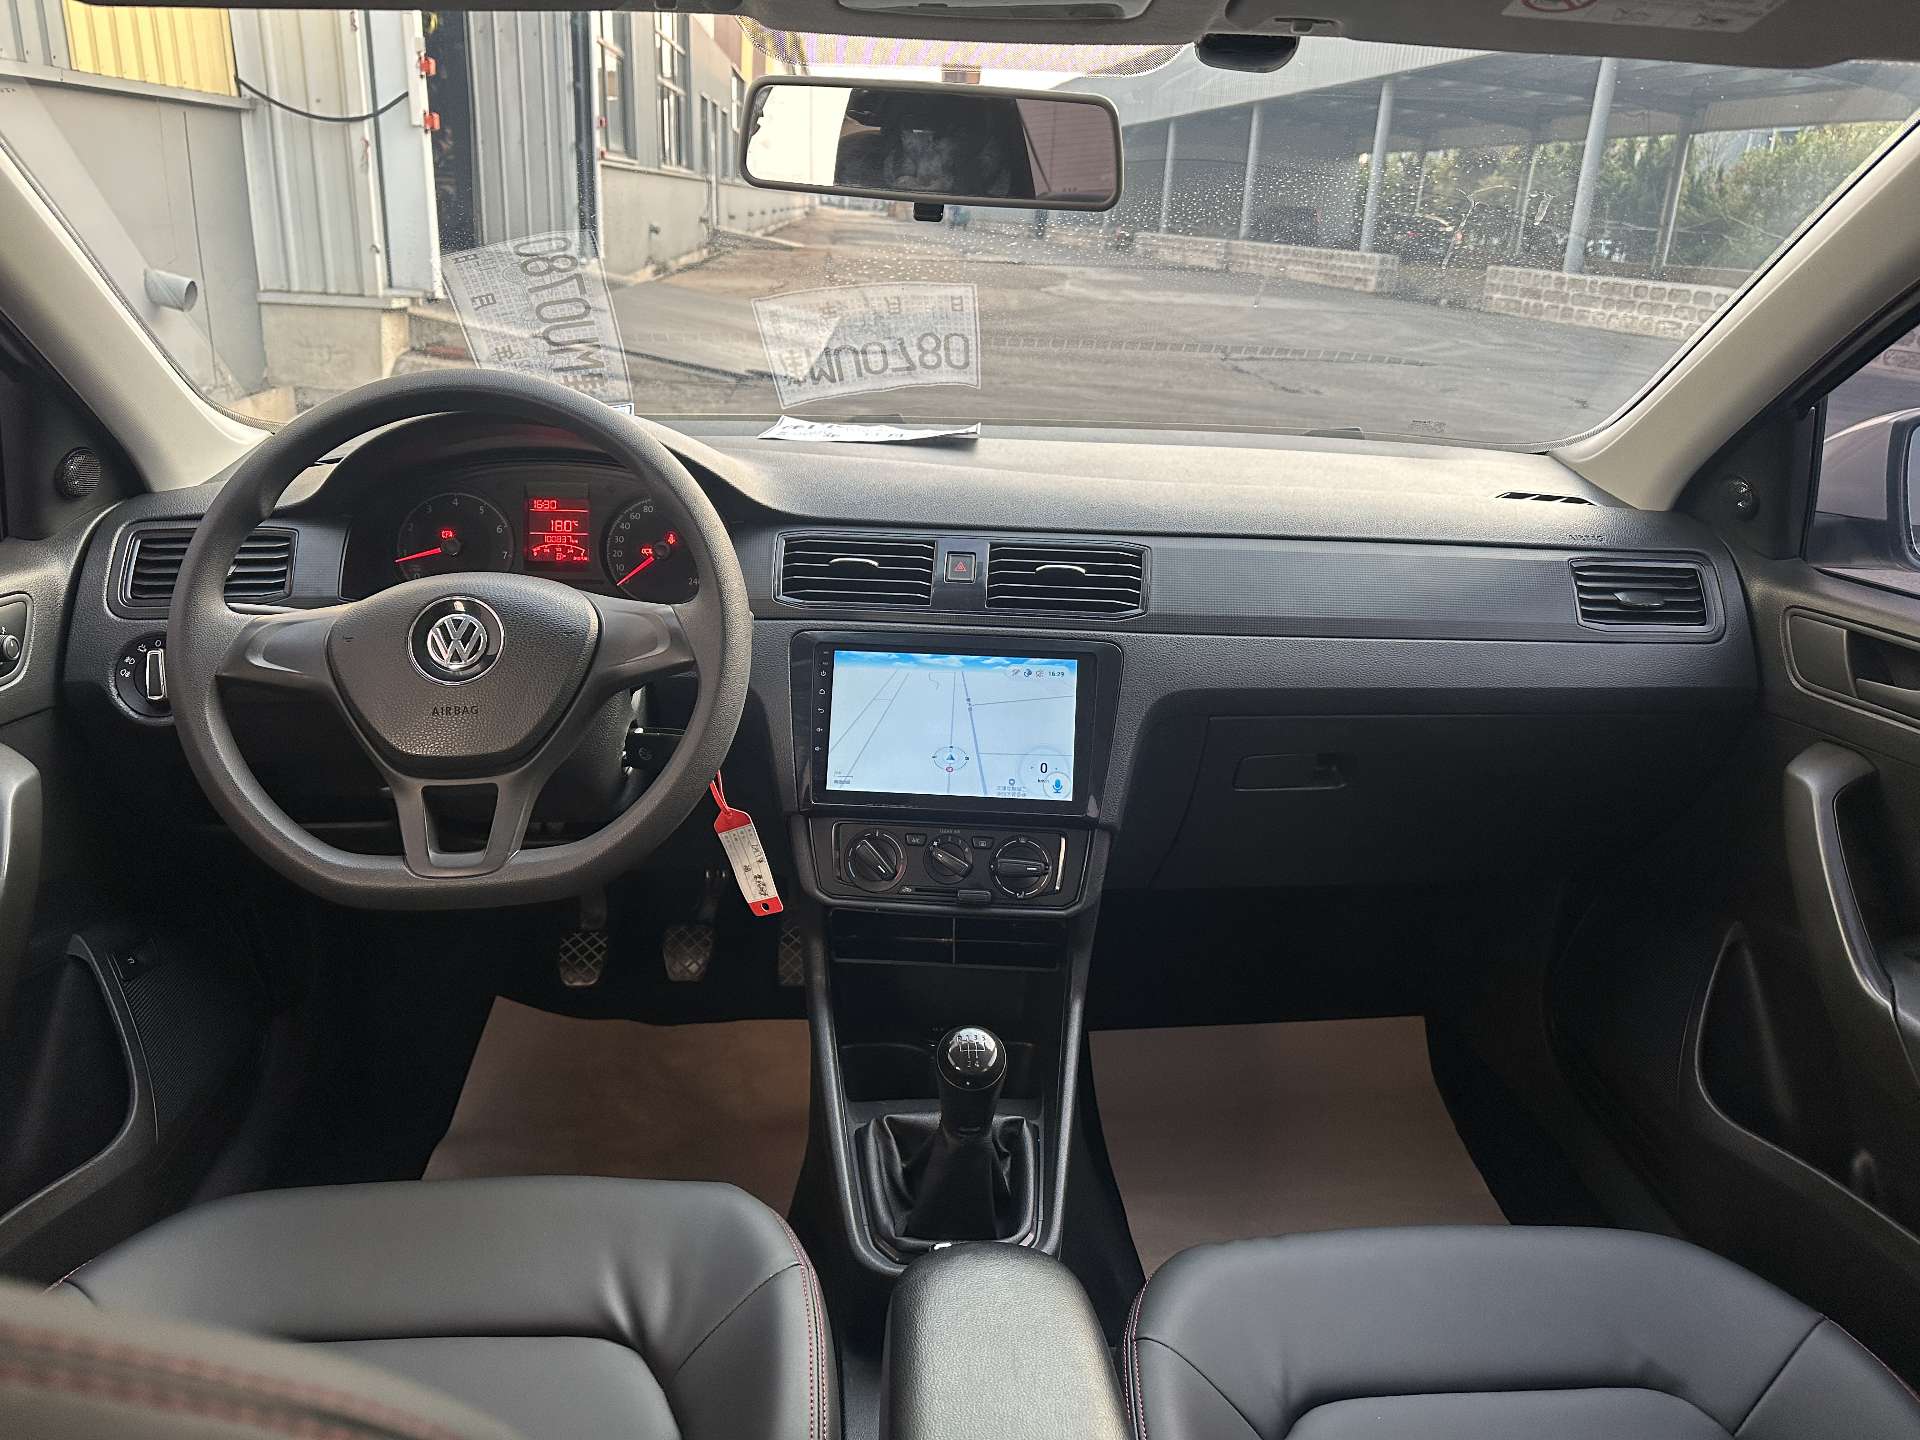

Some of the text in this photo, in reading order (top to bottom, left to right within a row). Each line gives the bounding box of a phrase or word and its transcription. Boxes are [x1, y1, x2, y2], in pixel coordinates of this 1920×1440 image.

[642, 505, 654, 513] 80
[629, 512, 640, 520] 60
[425, 504, 432, 513] 3
[452, 498, 459, 507] 4
[479, 506, 485, 515] 5
[496, 525, 503, 534] 6
[502, 551, 508, 560] 7
[620, 522, 631, 530] 40
[614, 535, 625, 543] 30
[612, 550, 623, 558] 20
[615, 563, 625, 572] 10
[427, 613, 488, 670] VW
[432, 705, 479, 716] AIRBAG
[1040, 762, 1048, 774] 0
